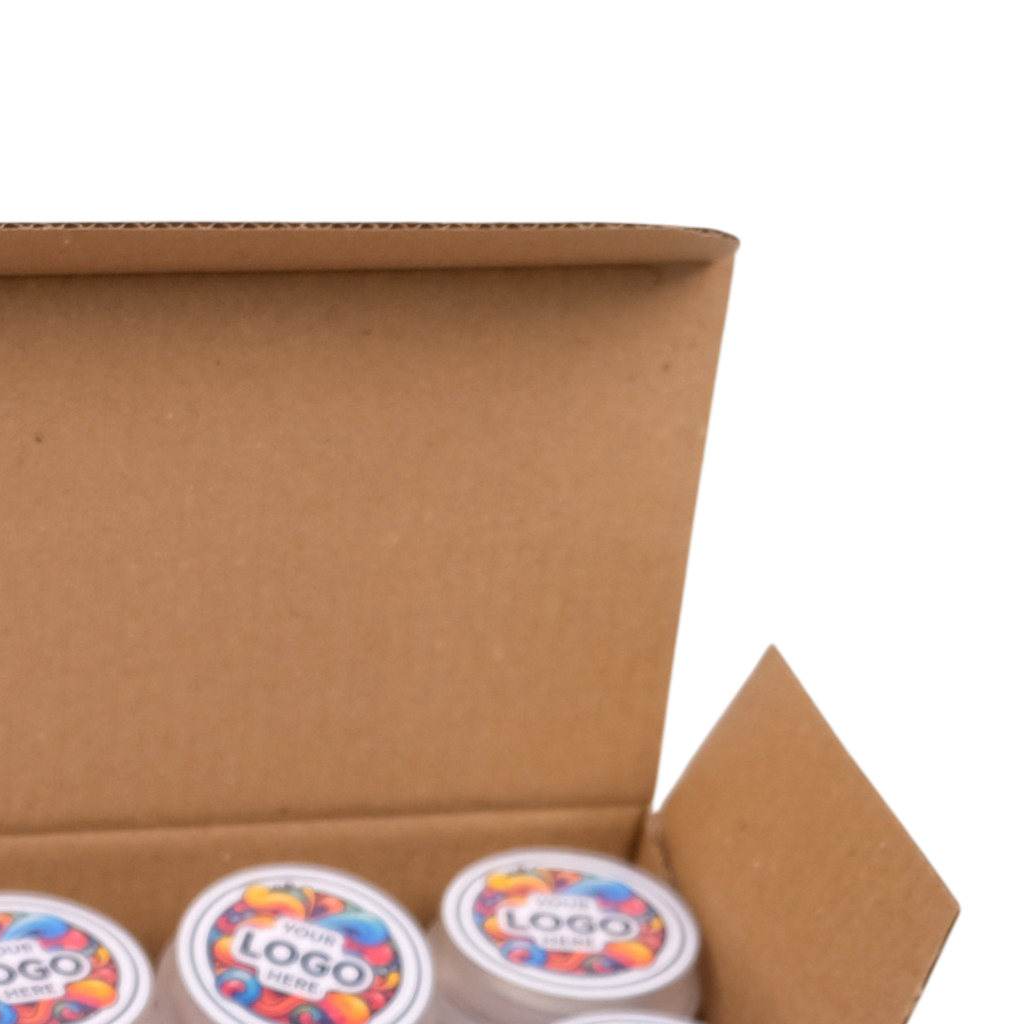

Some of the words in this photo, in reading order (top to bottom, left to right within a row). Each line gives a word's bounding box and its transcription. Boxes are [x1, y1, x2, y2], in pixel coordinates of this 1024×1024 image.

[284, 921, 337, 947] YOUR
[506, 909, 631, 936] LOGO
[239, 931, 366, 987] LOGO
[3, 983, 54, 1000] HERE
[268, 970, 318, 993] HERE
